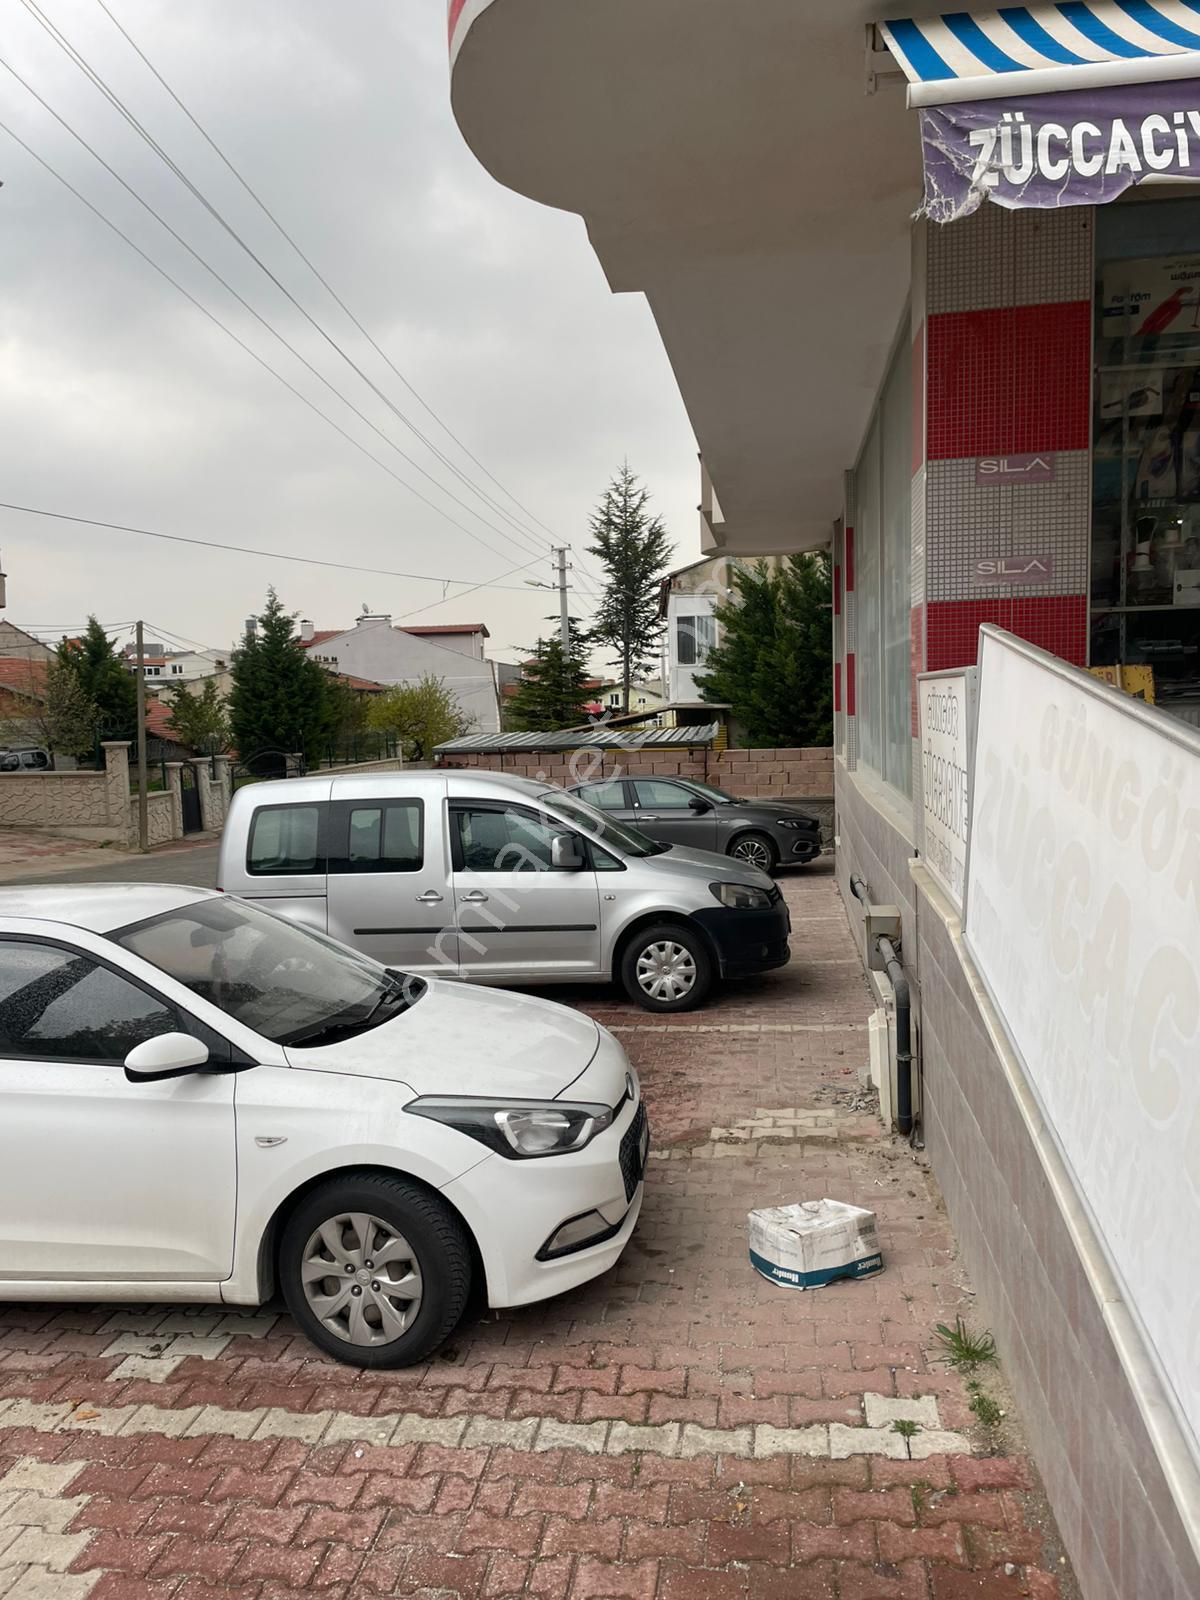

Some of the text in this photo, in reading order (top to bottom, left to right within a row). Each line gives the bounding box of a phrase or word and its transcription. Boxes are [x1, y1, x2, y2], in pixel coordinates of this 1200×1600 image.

[979, 457, 1049, 474] SILA
[976, 559, 1047, 575] SILA
[976, 743, 1200, 1124] ZÜCCAC
